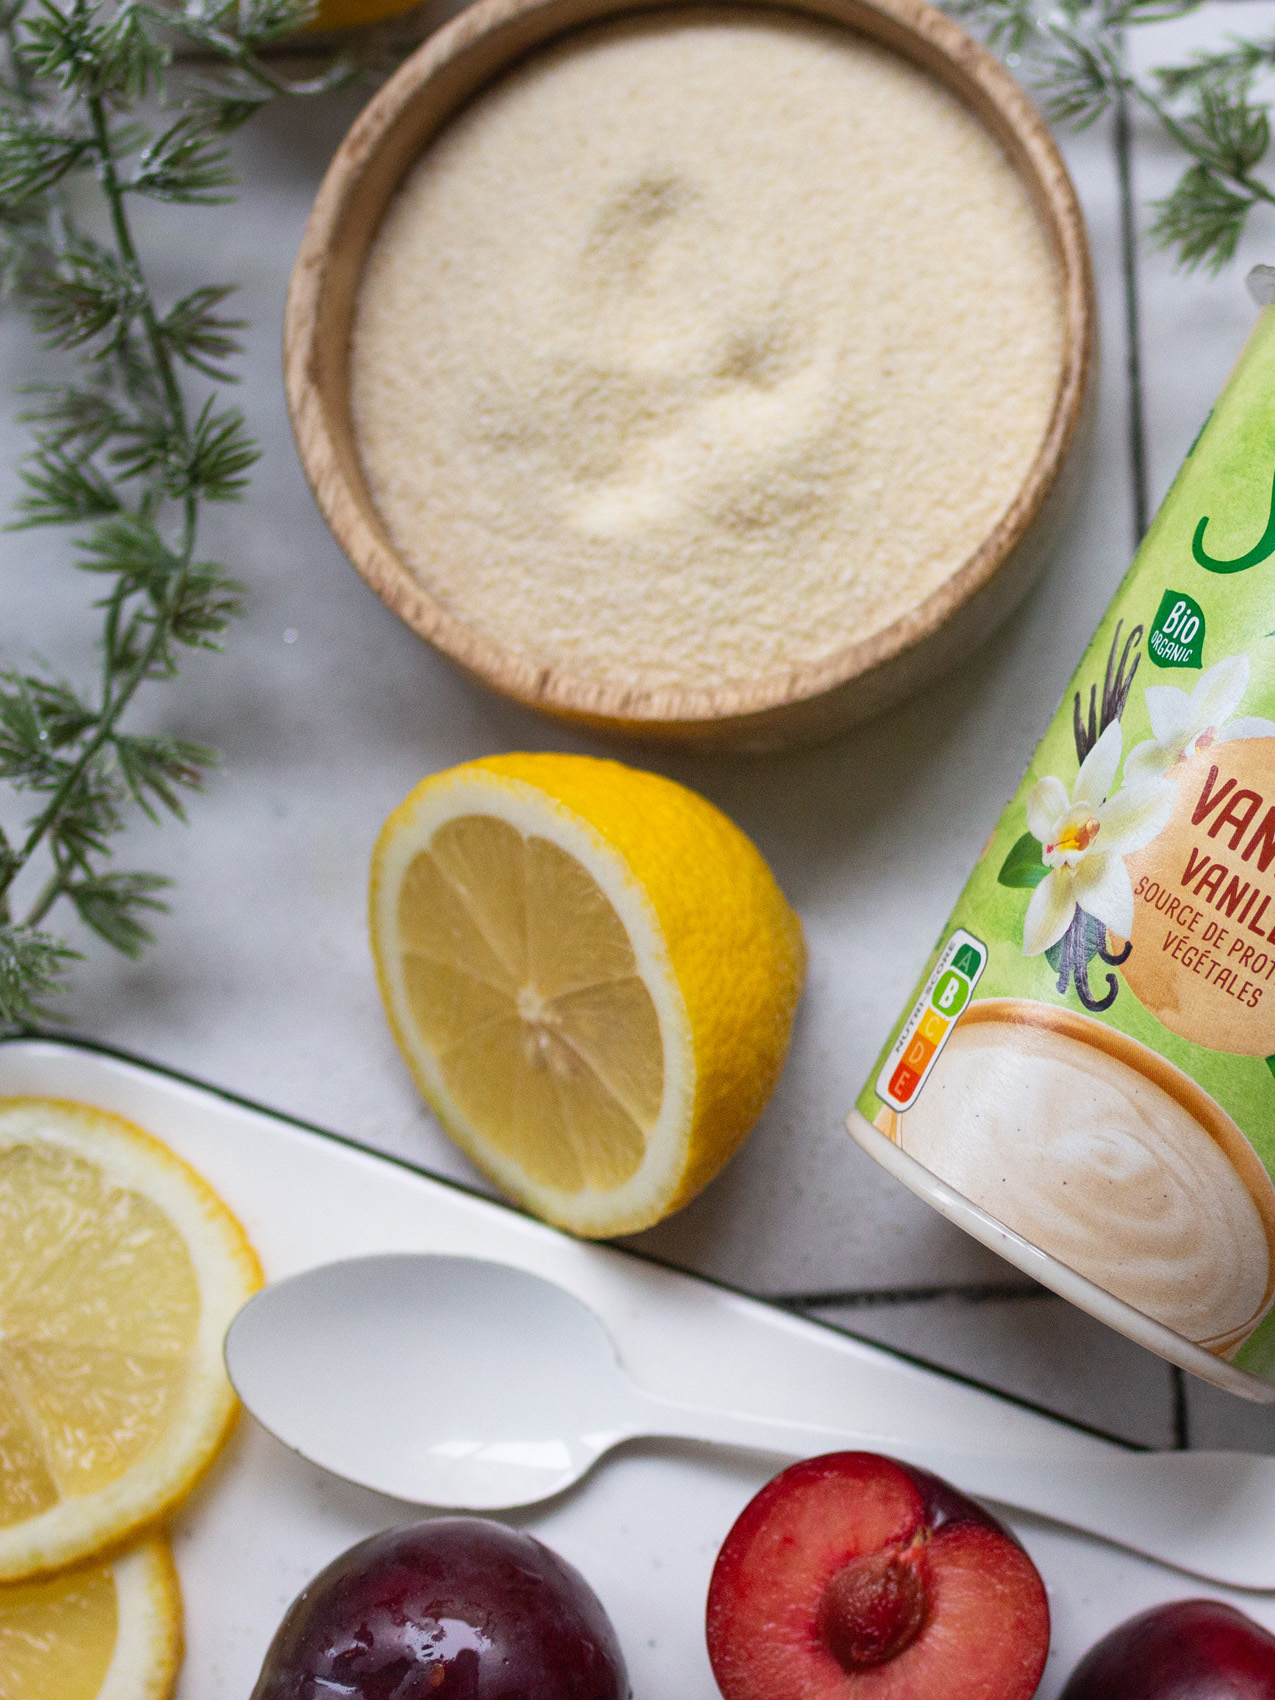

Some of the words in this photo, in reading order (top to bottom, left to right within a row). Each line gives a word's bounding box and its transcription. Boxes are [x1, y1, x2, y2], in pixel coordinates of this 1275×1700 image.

[1150, 629, 1193, 662] ORGANIC
[1133, 876, 1204, 934] SOURCE
[1204, 921, 1229, 950] DE
[957, 950, 973, 974] A
[1162, 931, 1263, 1009] VÉGÉTALES
[895, 941, 957, 1053] NUTRI-SCORE
[938, 977, 960, 1009] B
[925, 1016, 941, 1037] C
[908, 1041, 925, 1064] D
[893, 1070, 911, 1096] E
